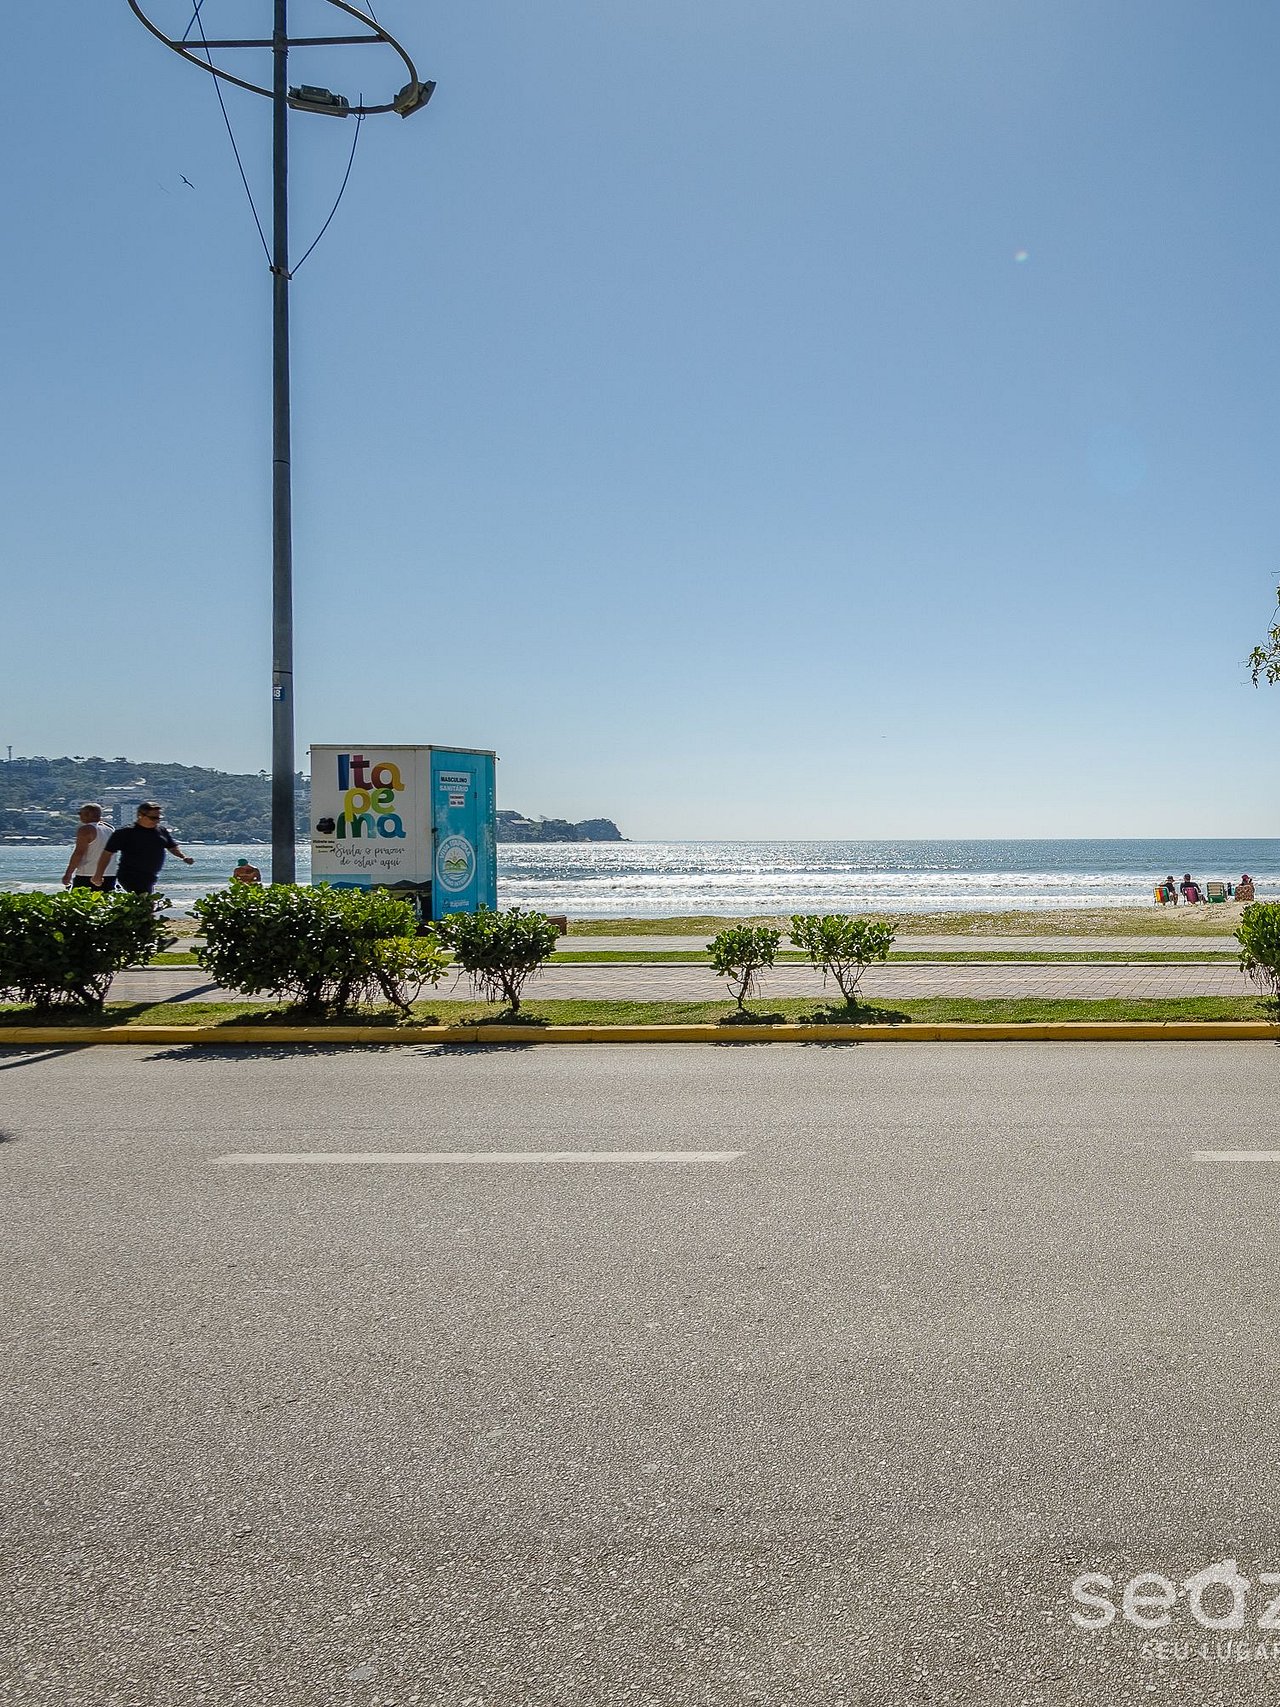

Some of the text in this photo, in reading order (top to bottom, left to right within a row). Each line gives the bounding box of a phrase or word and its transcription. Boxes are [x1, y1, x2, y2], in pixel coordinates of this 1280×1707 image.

[340, 856, 402, 870] de estar aqui
